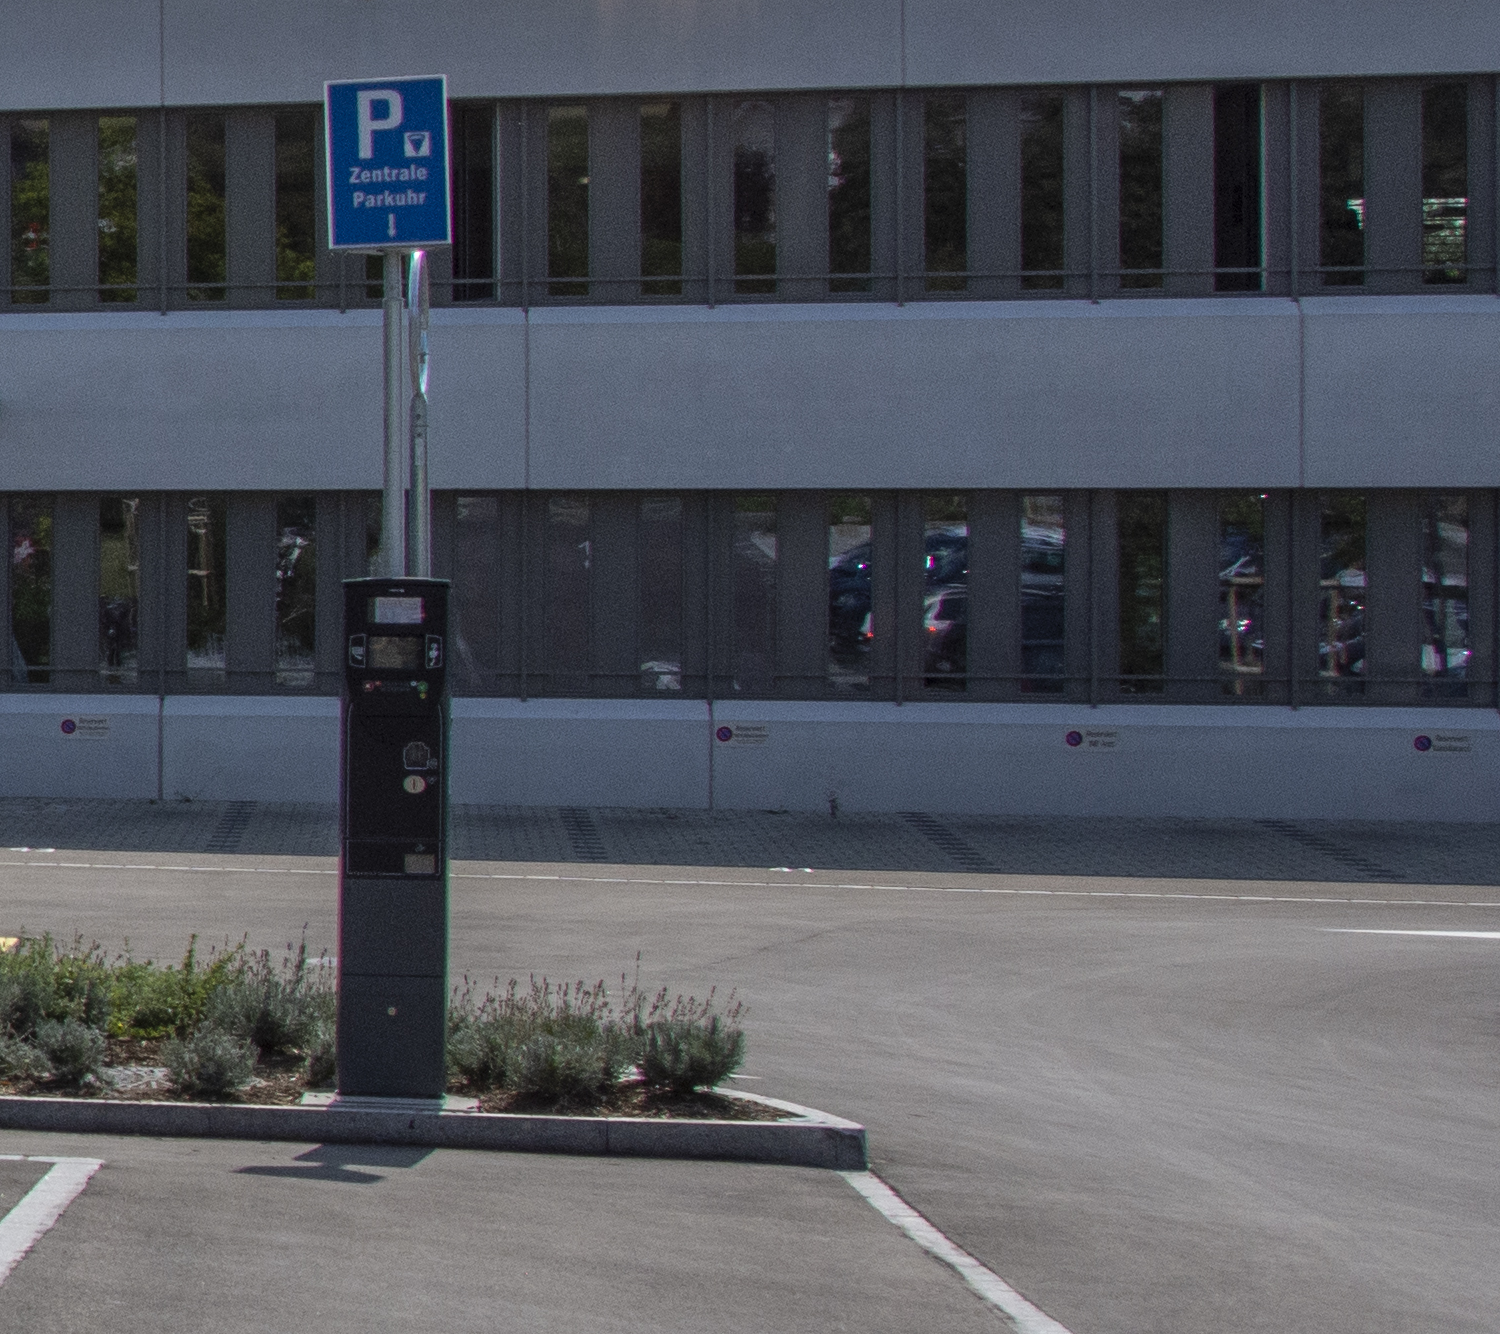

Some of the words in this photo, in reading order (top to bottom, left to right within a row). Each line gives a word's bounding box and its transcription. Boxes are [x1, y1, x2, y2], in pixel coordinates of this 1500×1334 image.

[356, 89, 404, 160] P
[349, 164, 428, 184] Zentrale
[353, 189, 426, 208] Parkuhr
